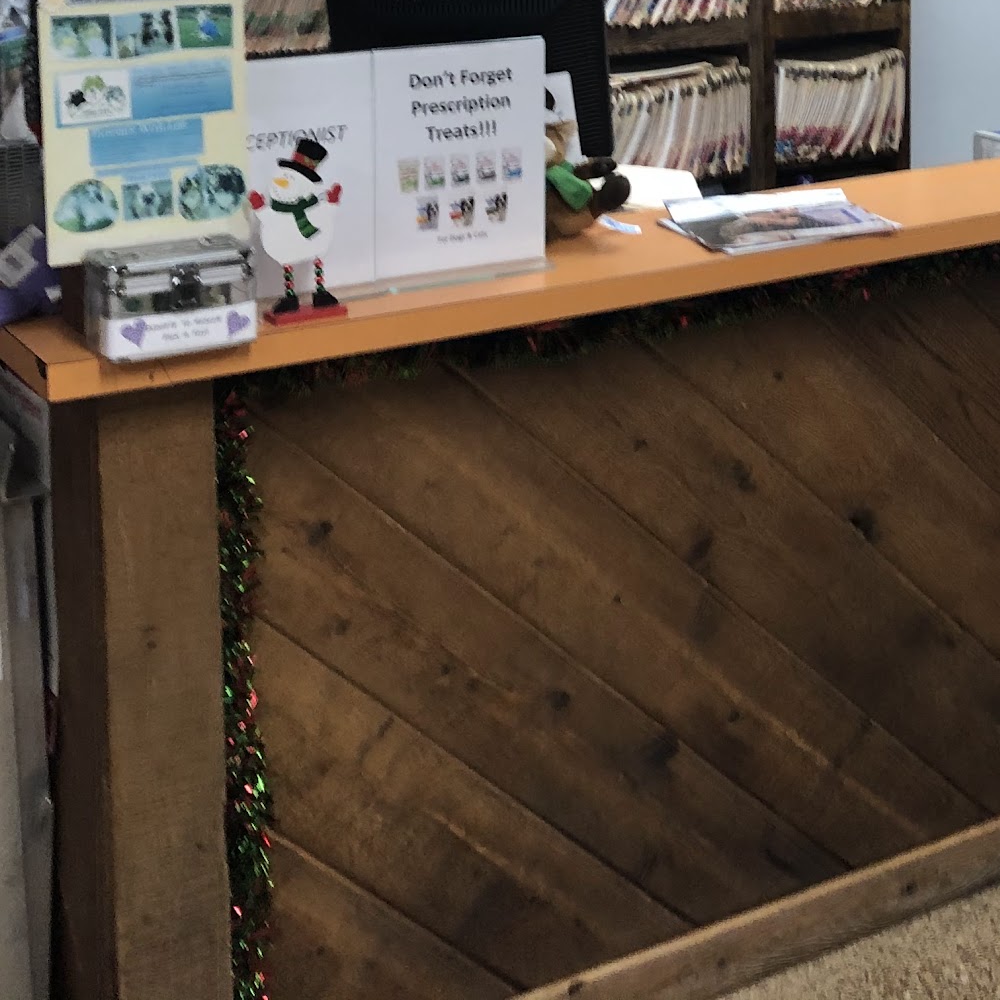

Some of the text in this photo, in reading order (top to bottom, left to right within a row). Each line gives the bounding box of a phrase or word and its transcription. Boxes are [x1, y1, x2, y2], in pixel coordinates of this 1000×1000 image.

[409, 67, 513, 90] Don't Forget
[411, 93, 512, 118] Prescription
[425, 119, 498, 143] Treats!!!
